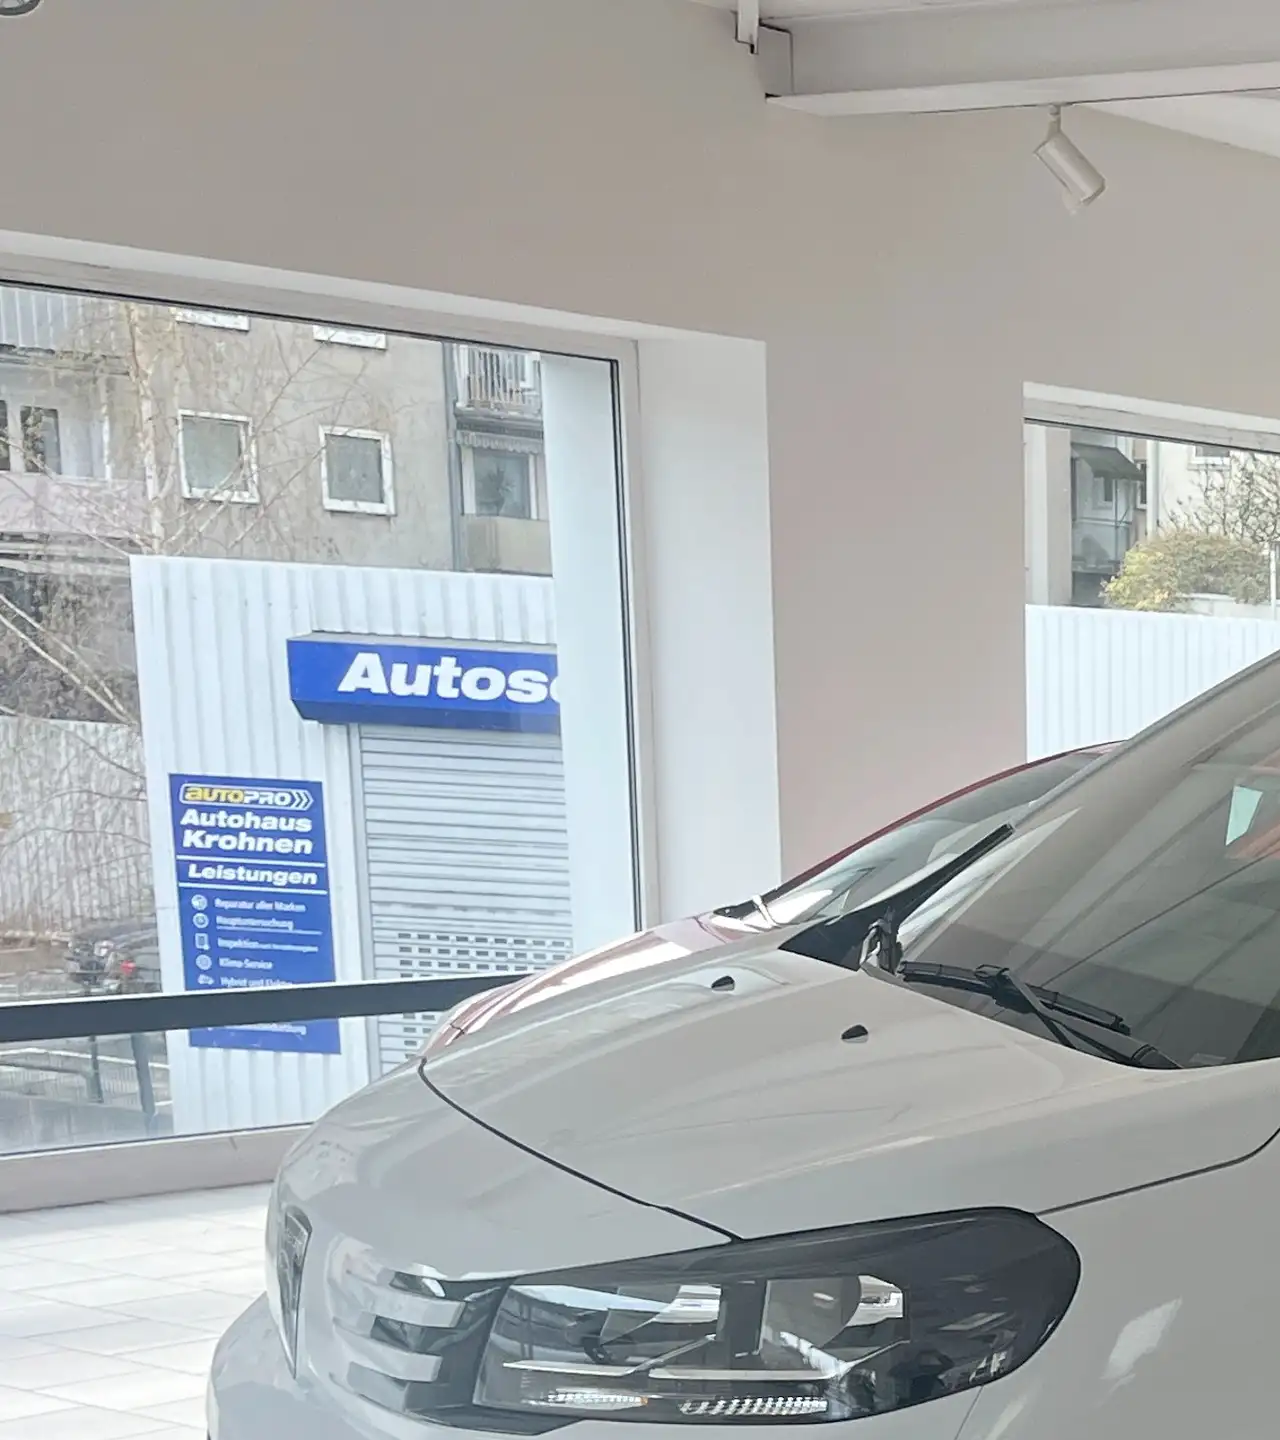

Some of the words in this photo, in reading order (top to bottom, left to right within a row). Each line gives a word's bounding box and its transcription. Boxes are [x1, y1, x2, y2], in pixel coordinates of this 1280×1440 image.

[337, 652, 560, 704] Autos
[180, 808, 312, 832] Autohaus
[182, 829, 313, 855] Krohnen
[188, 863, 318, 886] Leistungen
